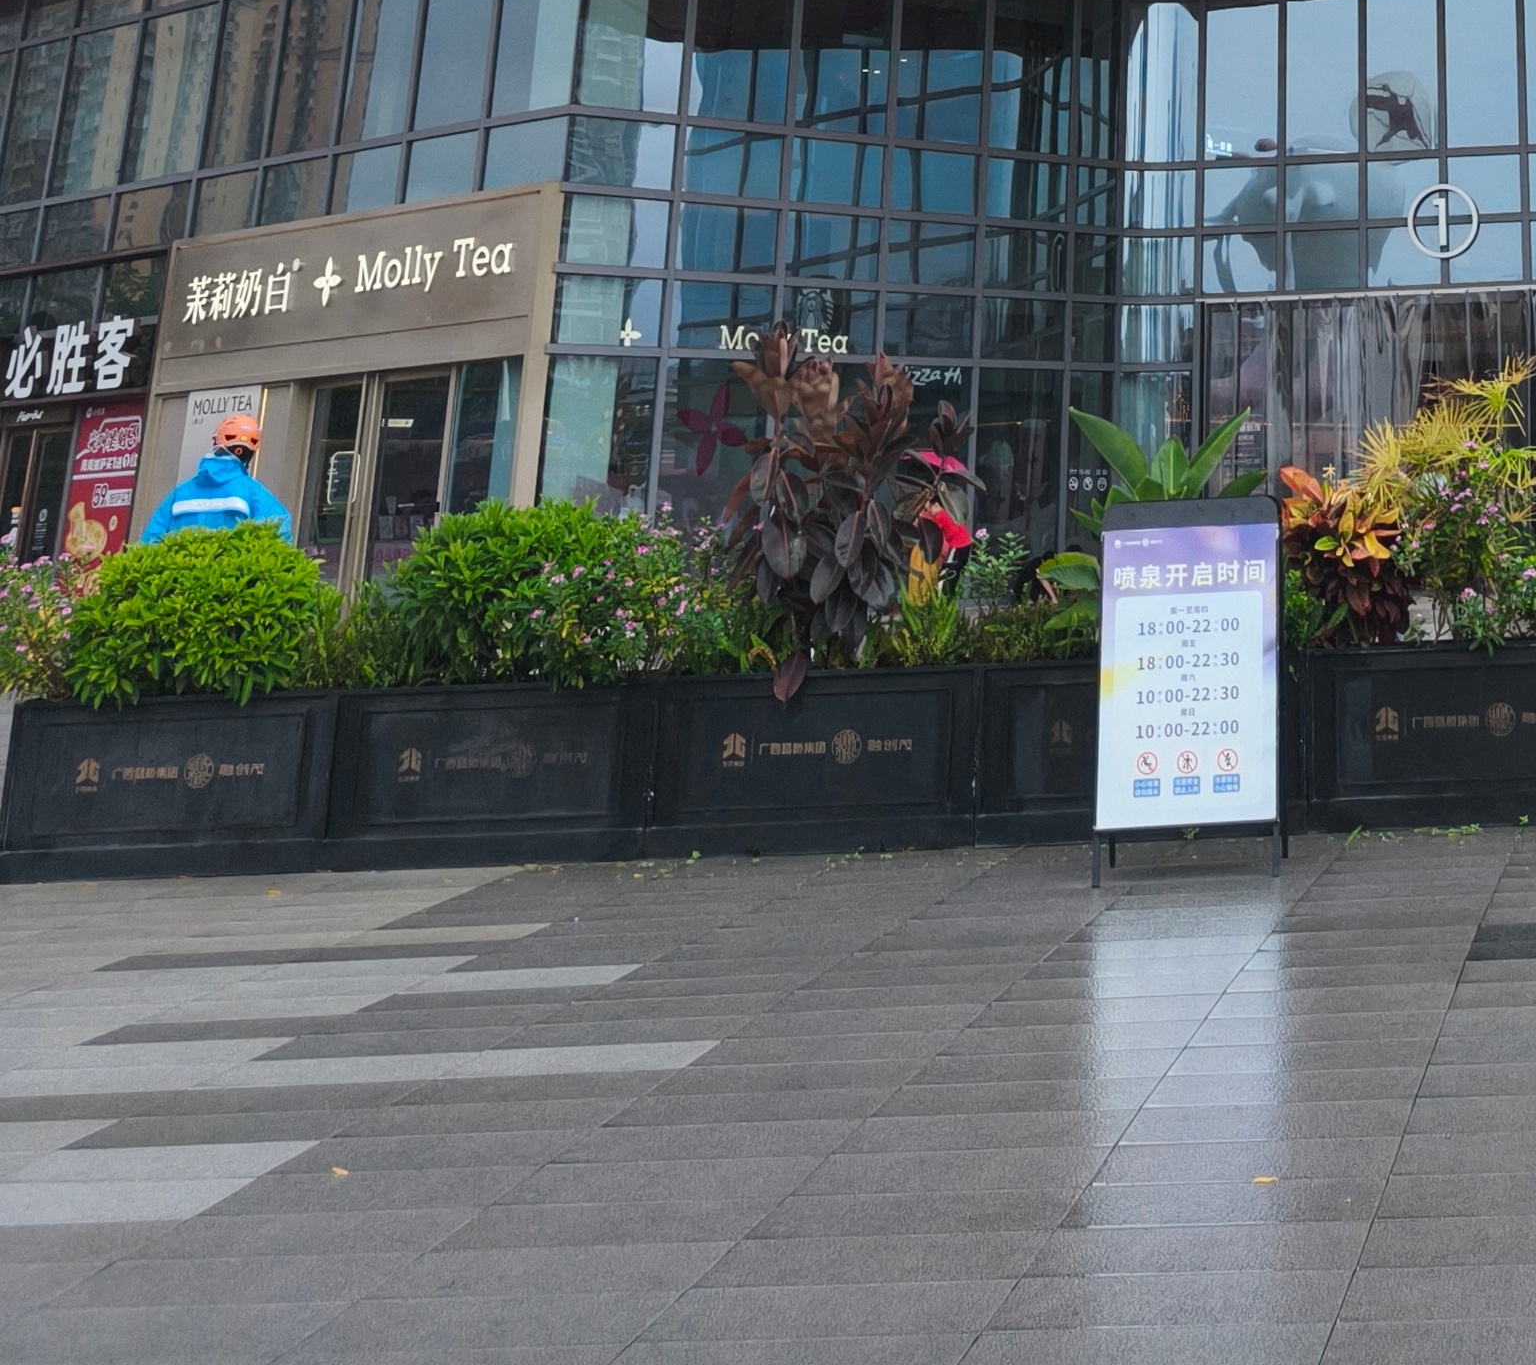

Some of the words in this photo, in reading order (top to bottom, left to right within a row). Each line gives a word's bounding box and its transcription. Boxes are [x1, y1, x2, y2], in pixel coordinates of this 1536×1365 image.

[354, 245, 443, 293] Molly
[453, 237, 513, 278] Tea
[183, 262, 292, 324] 茉莉奶白
[801, 329, 848, 354] Tea
[5, 315, 135, 399] 必胜客
[904, 366, 942, 386] izza
[193, 397, 230, 416] MOLLY
[232, 395, 252, 412] TEA
[1113, 560, 1266, 590] 喷泉开启时间
[1170, 606, 1208, 615] 周一至周四
[1138, 618, 1239, 636] 18:00-22:00
[1181, 639, 1196, 648] 周五
[1137, 652, 1239, 670] 18:00-22:30
[1181, 673, 1196, 681] 周六
[1136, 686, 1239, 704] 10:00-22:30
[1180, 707, 1195, 716] 周日
[1135, 720, 1239, 738] 10:00-22:00
